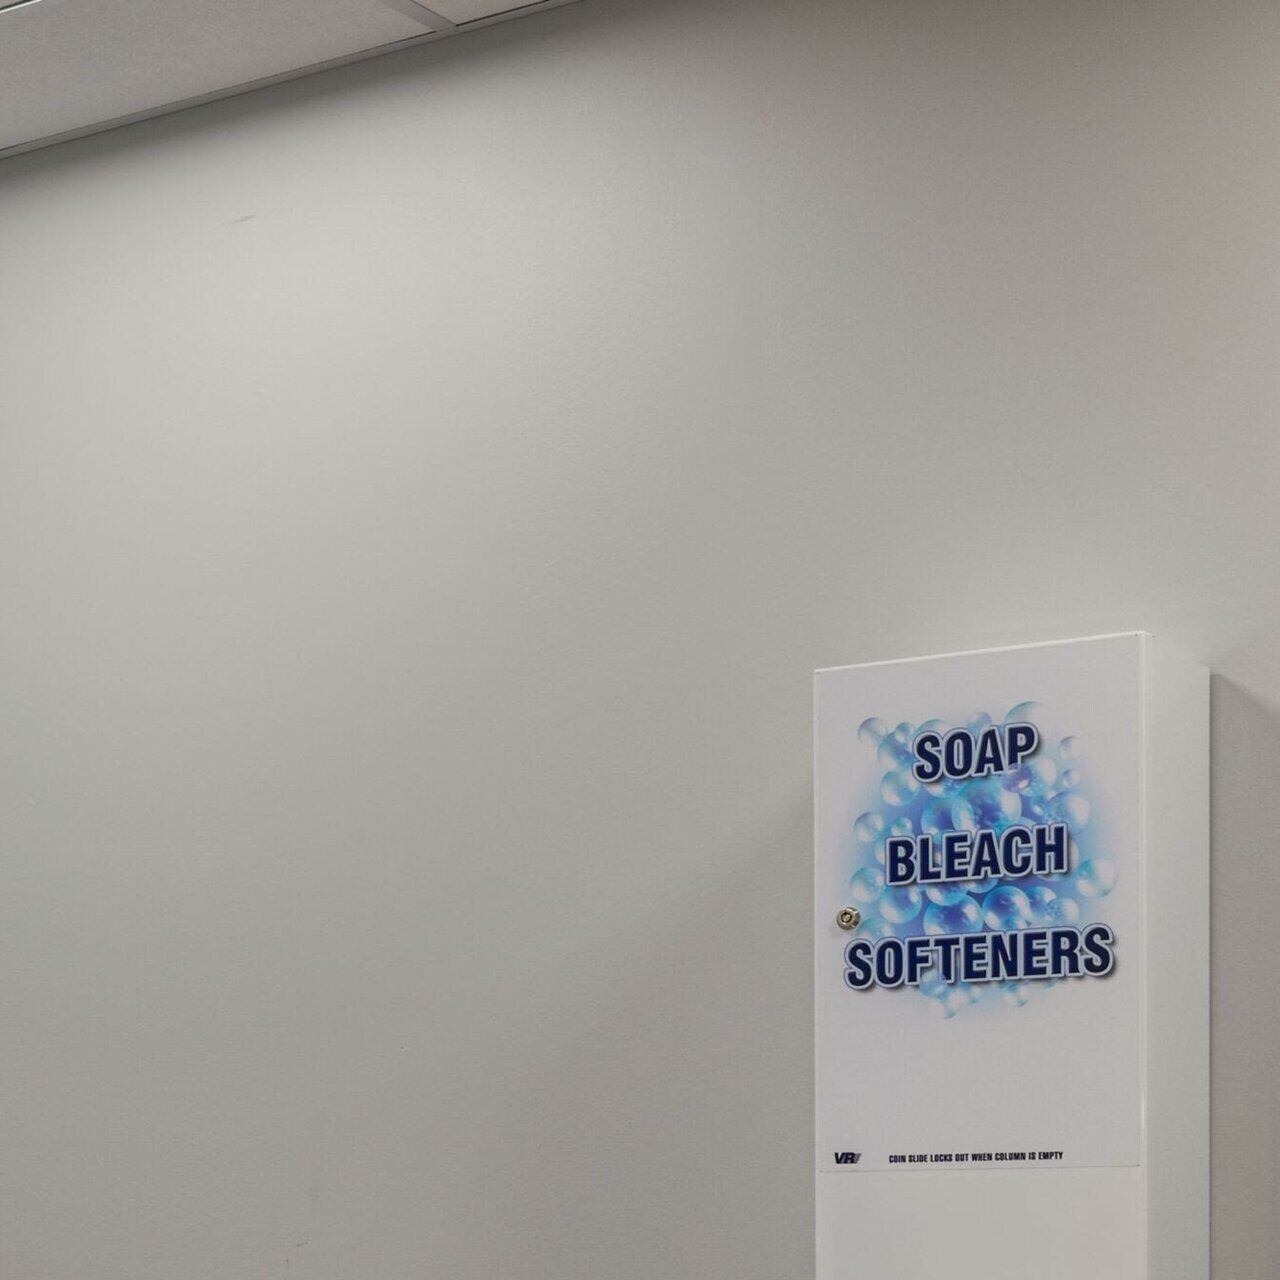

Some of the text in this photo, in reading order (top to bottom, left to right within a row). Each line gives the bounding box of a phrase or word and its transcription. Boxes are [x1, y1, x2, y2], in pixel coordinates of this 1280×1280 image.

[914, 723, 1038, 782] SOAP
[887, 824, 1067, 884] BLEACH
[846, 925, 1115, 988] SOFTENERS
[888, 1151, 1064, 1163] COIN SLIDE LOCKS OUT WHEN COLUMN IS EMPTY
